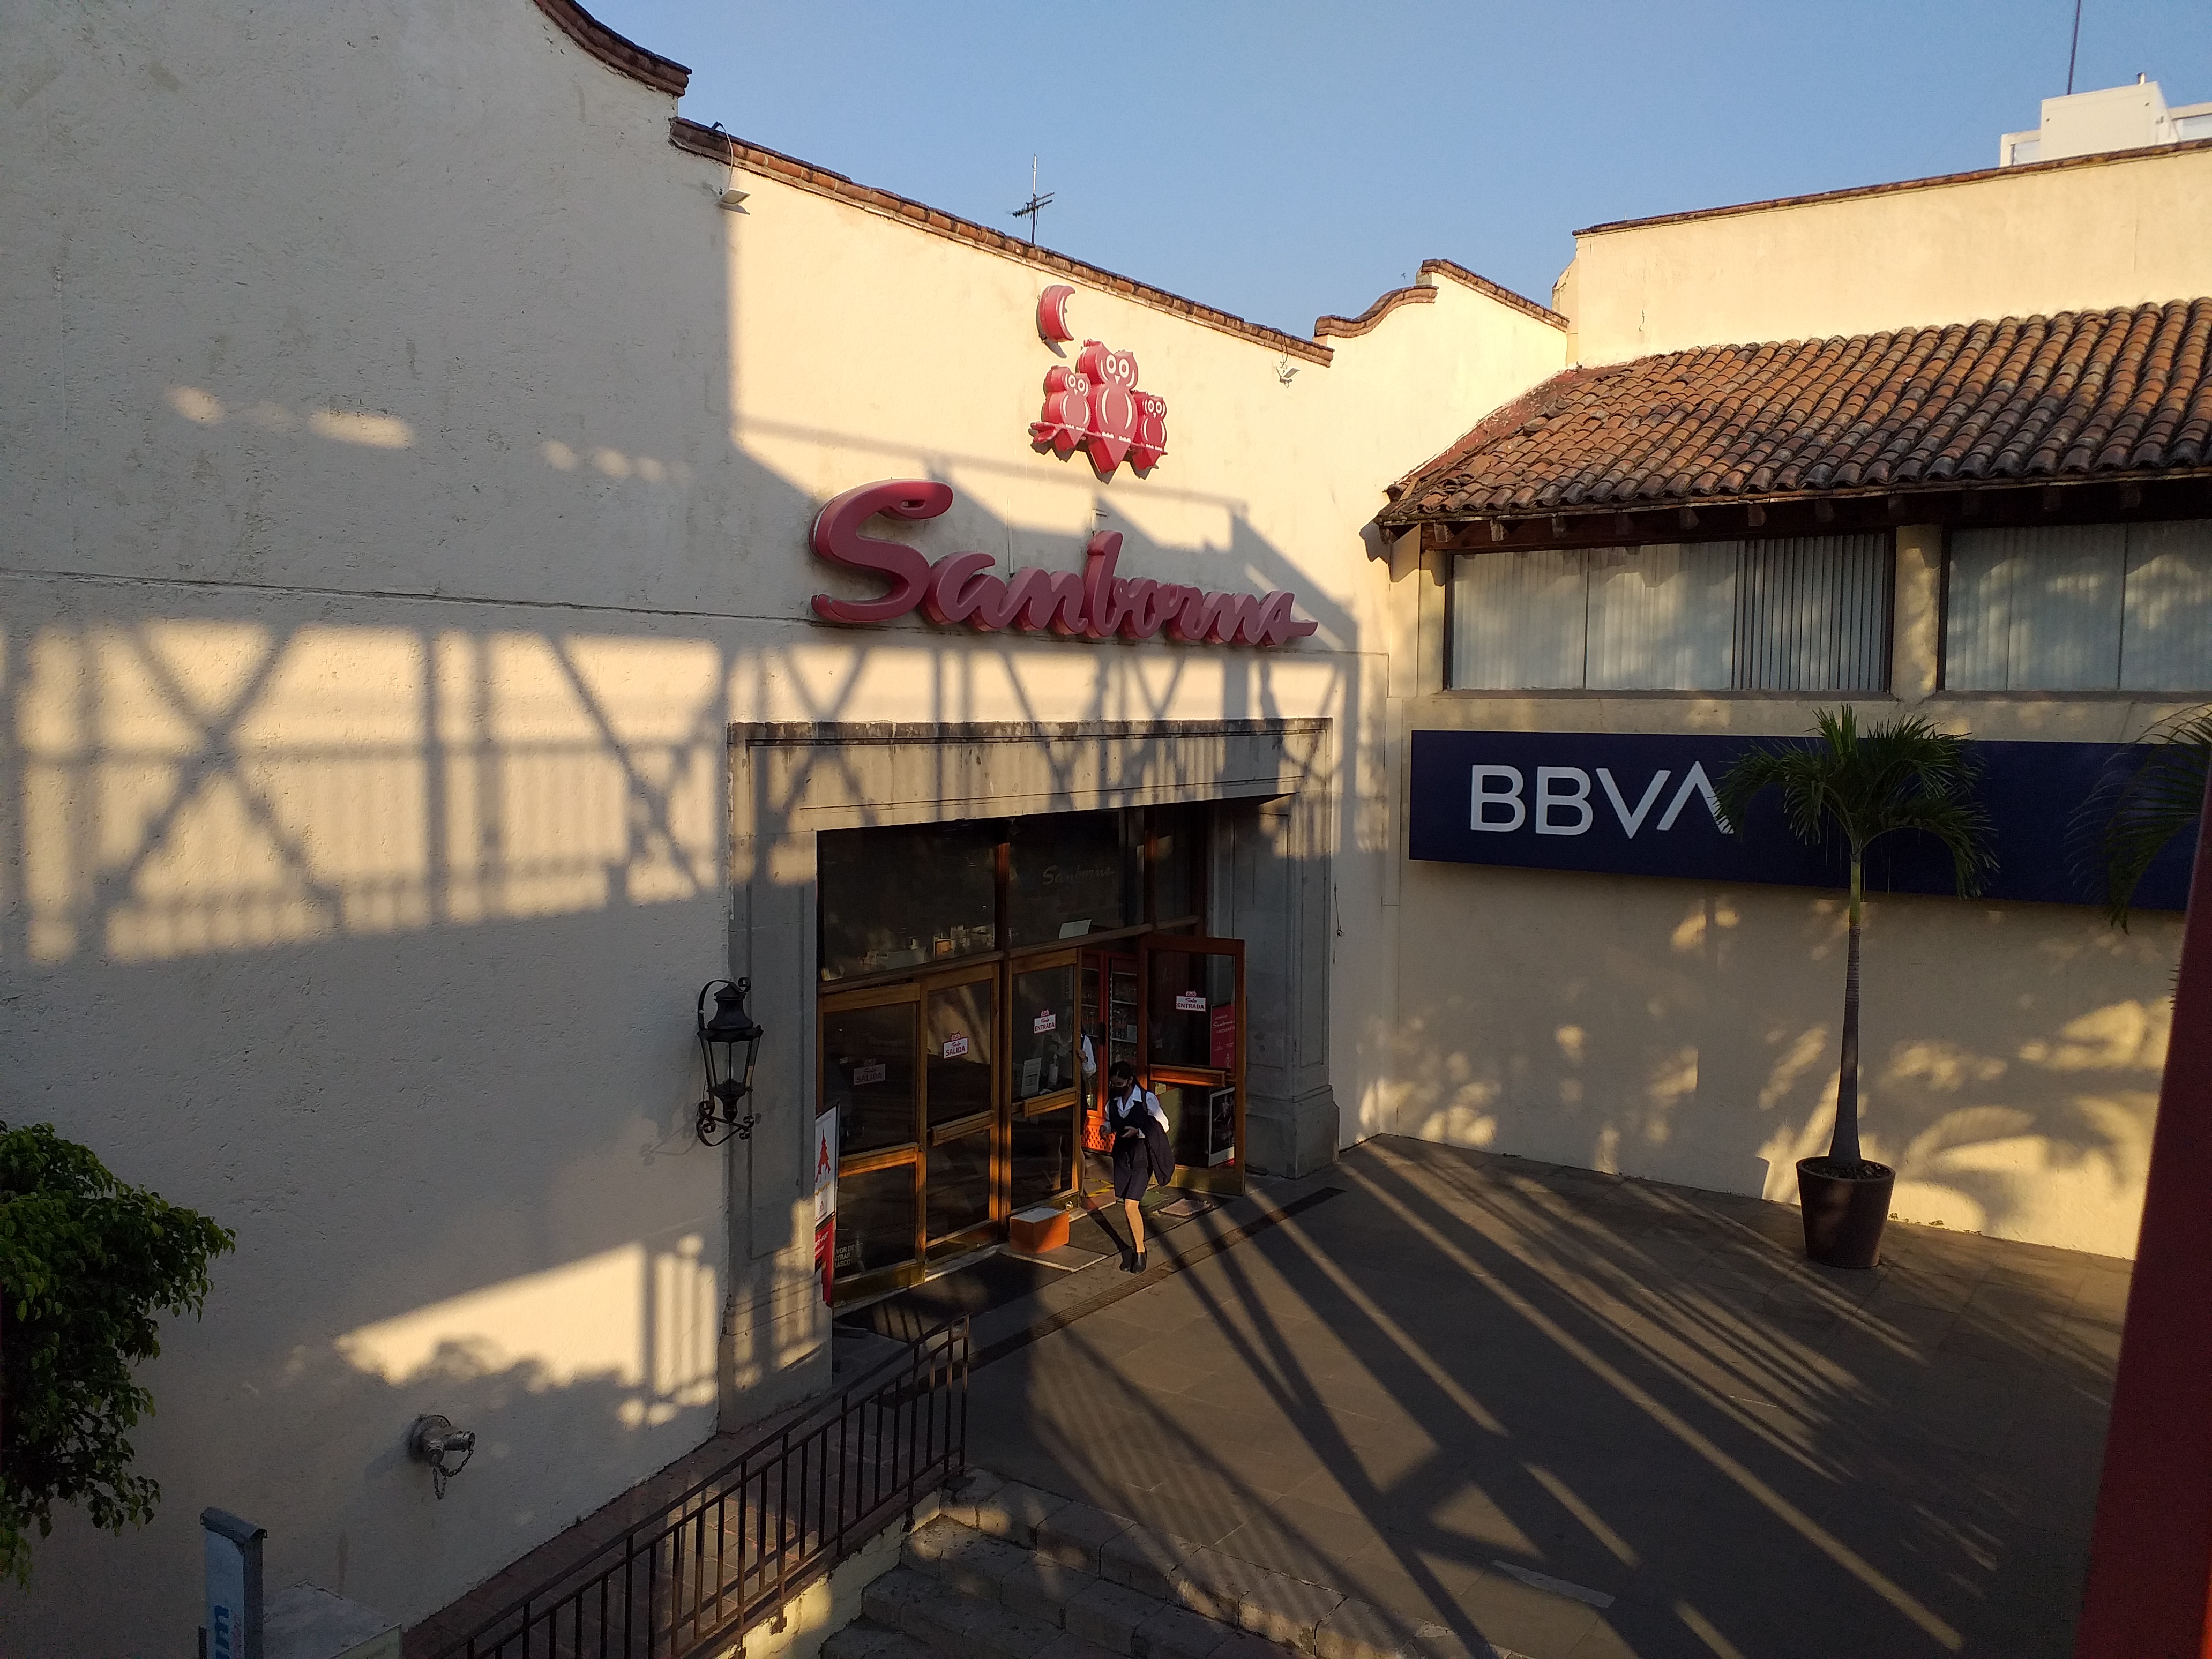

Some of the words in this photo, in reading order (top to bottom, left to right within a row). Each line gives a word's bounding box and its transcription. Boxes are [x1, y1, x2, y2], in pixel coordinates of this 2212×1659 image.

[809, 477, 1318, 647] Sanborns
[1470, 760, 1735, 839] BBVA
[1035, 1022, 1055, 1032] ENTRADA
[946, 1045, 966, 1056] SALIDA
[856, 1072, 883, 1083] SALIDA
